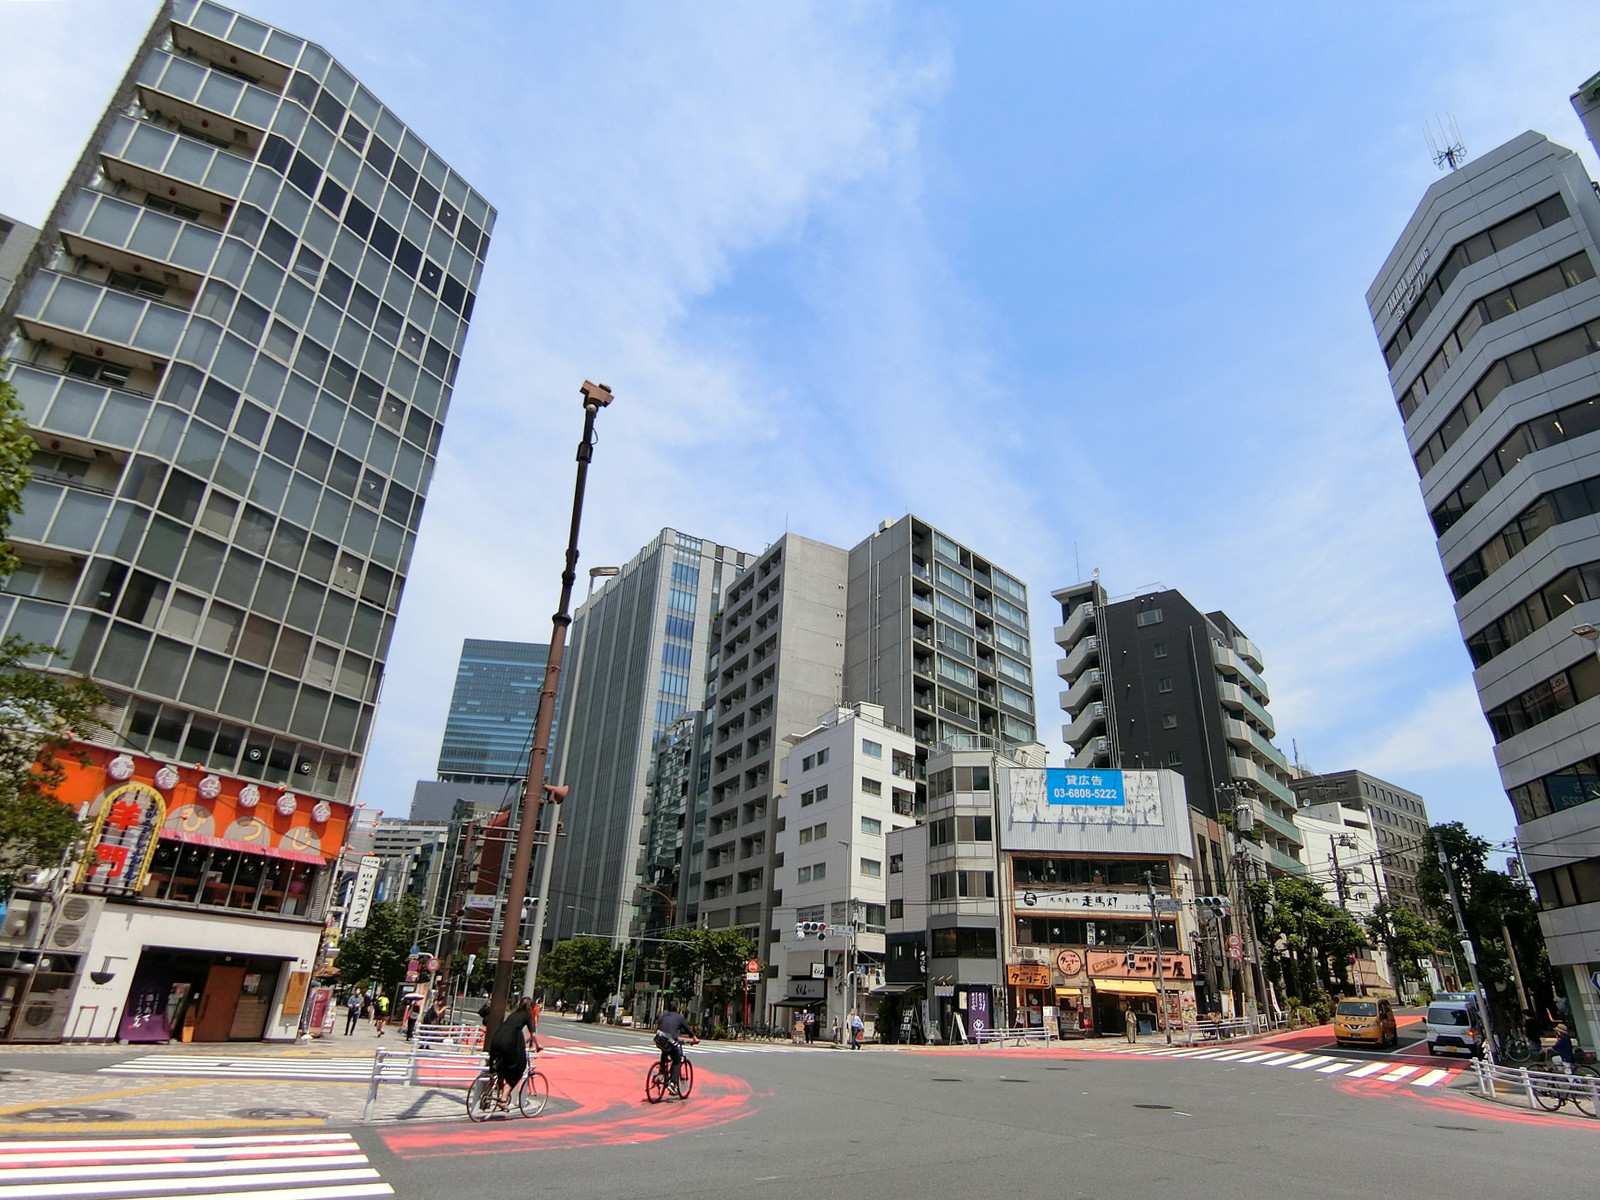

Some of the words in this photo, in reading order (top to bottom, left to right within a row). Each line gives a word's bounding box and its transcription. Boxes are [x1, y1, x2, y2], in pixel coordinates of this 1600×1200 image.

[1066, 774, 1103, 786] 貸広告
[1053, 788, 1117, 799] 03-6808-5222
[1082, 895, 1118, 908] 走馬灯
[1011, 972, 1048, 985] ターリー屋
